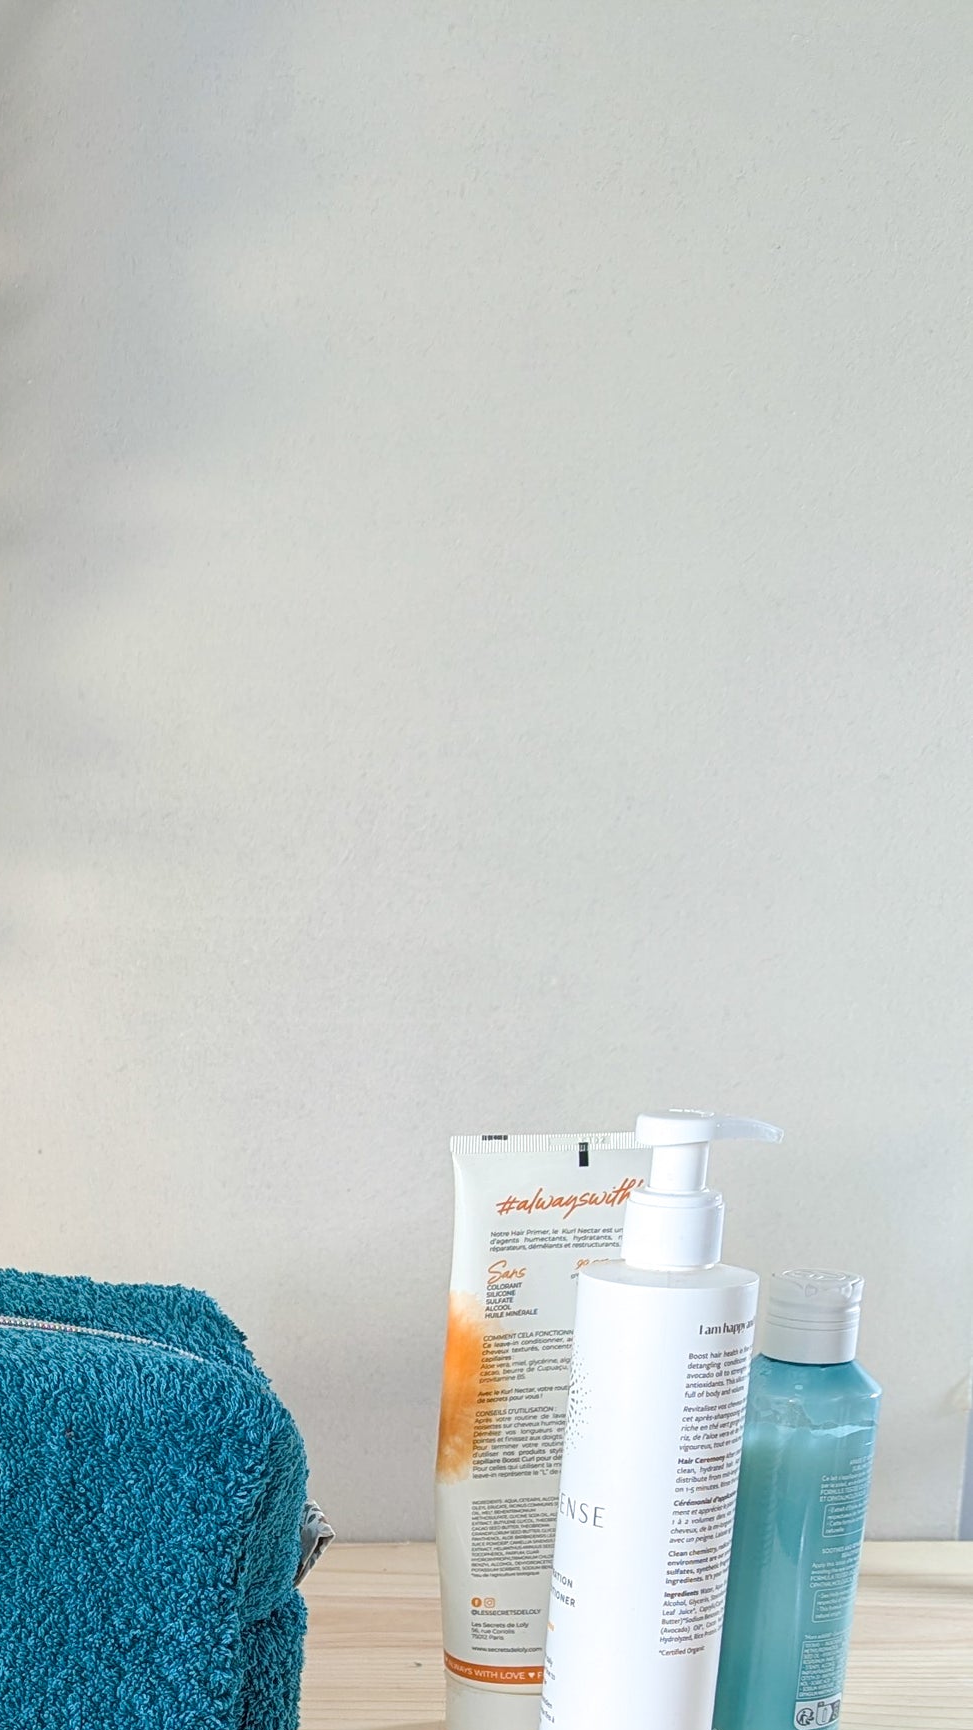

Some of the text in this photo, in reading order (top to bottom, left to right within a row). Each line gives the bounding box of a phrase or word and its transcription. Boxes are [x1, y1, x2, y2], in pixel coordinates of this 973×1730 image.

[496, 1177, 644, 1220] #alwayswith
[487, 1259, 527, 1285] Sans
[487, 1282, 523, 1291] COLORANT
[486, 1290, 516, 1298] SILICONE
[486, 1297, 514, 1305] SULFATE
[485, 1304, 512, 1312] ALCOOL
[485, 1311, 504, 1319] HUILE
[705, 1325, 721, 1335] am
[483, 1333, 516, 1341] COMMENT
[535, 1329, 574, 1337] FONCTIONN
[474, 1670, 498, 1679] WITH
